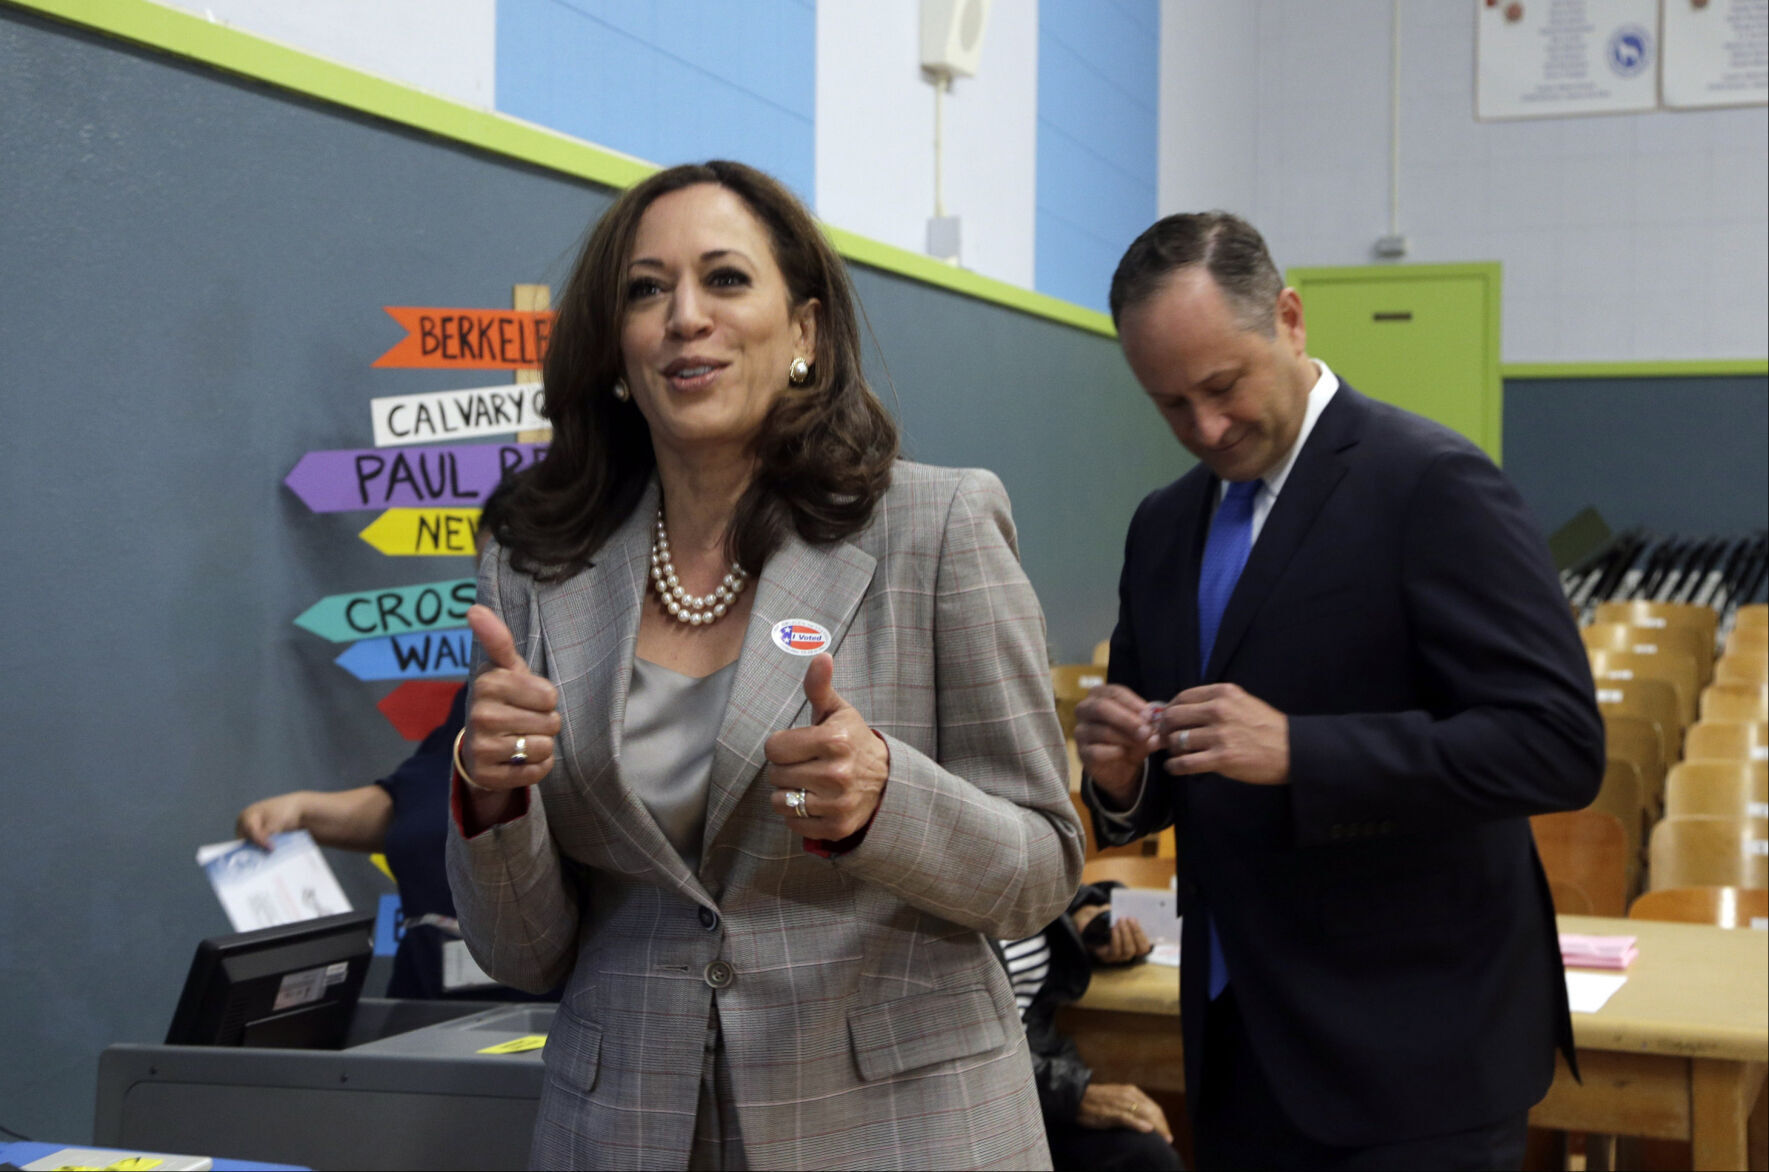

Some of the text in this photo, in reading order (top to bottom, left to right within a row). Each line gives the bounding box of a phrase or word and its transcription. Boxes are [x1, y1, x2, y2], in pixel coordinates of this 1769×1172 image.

[387, 391, 523, 437] CALVARY
[355, 452, 479, 504] PAUL
[345, 583, 477, 633] CROS
[390, 635, 470, 672] WAL
